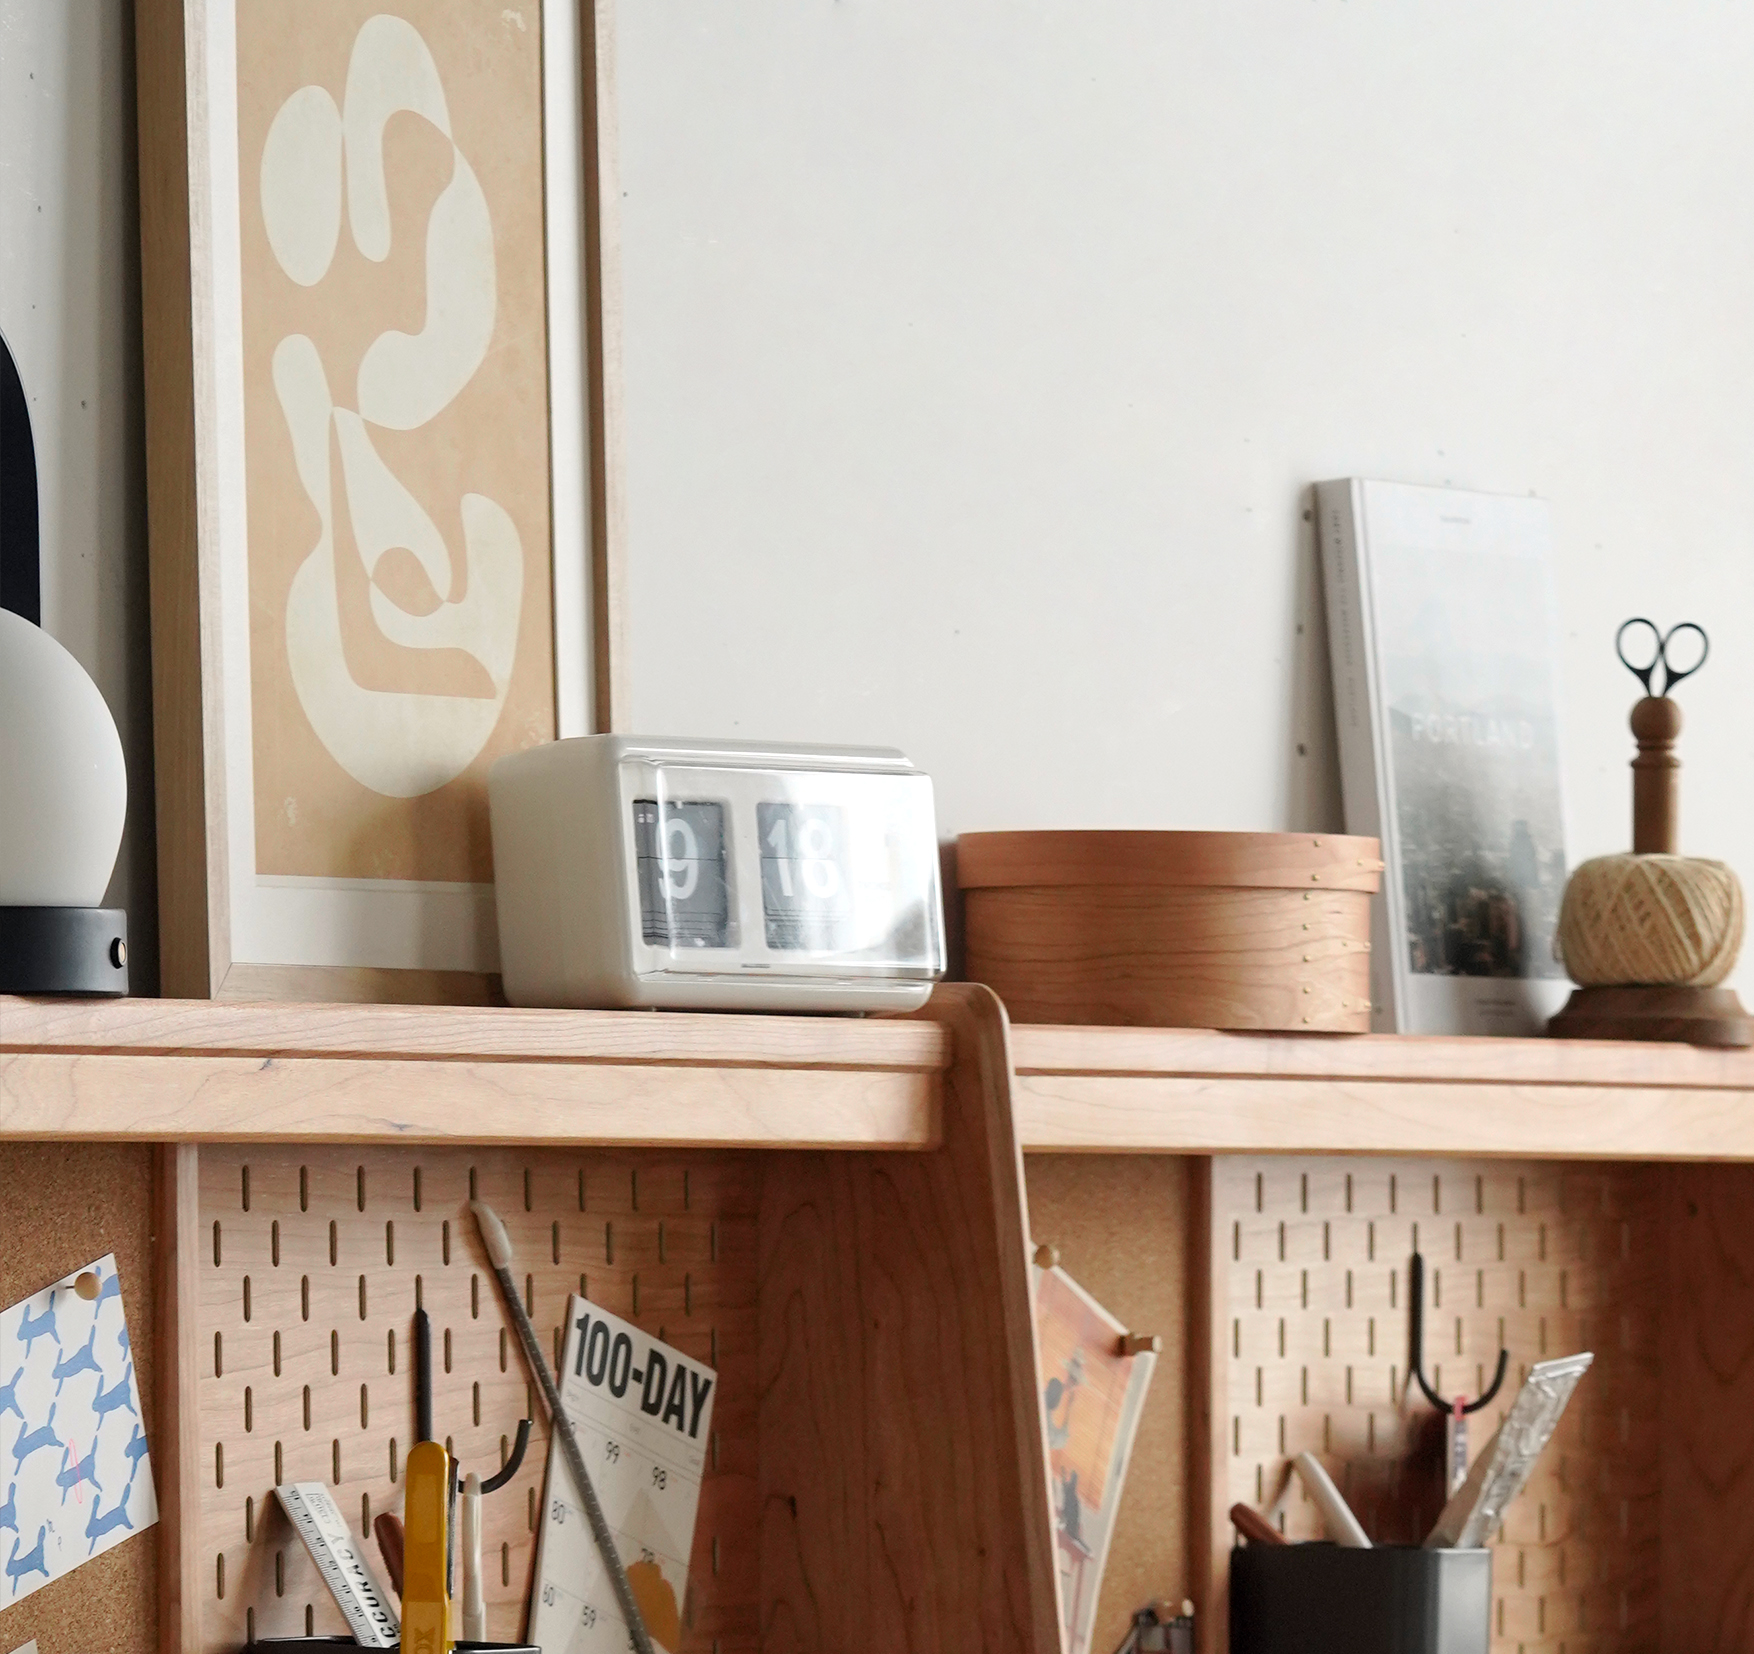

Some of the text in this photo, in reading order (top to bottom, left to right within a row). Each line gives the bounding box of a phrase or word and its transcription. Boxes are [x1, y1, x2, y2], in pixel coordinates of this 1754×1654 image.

[1412, 712, 1534, 749] PORTLAND
[654, 817, 840, 901] 9 18
[575, 1313, 713, 1440] 100-DAY
[605, 1440, 621, 1465] 99
[652, 1466, 668, 1490] 98
[582, 1605, 597, 1630] 59
